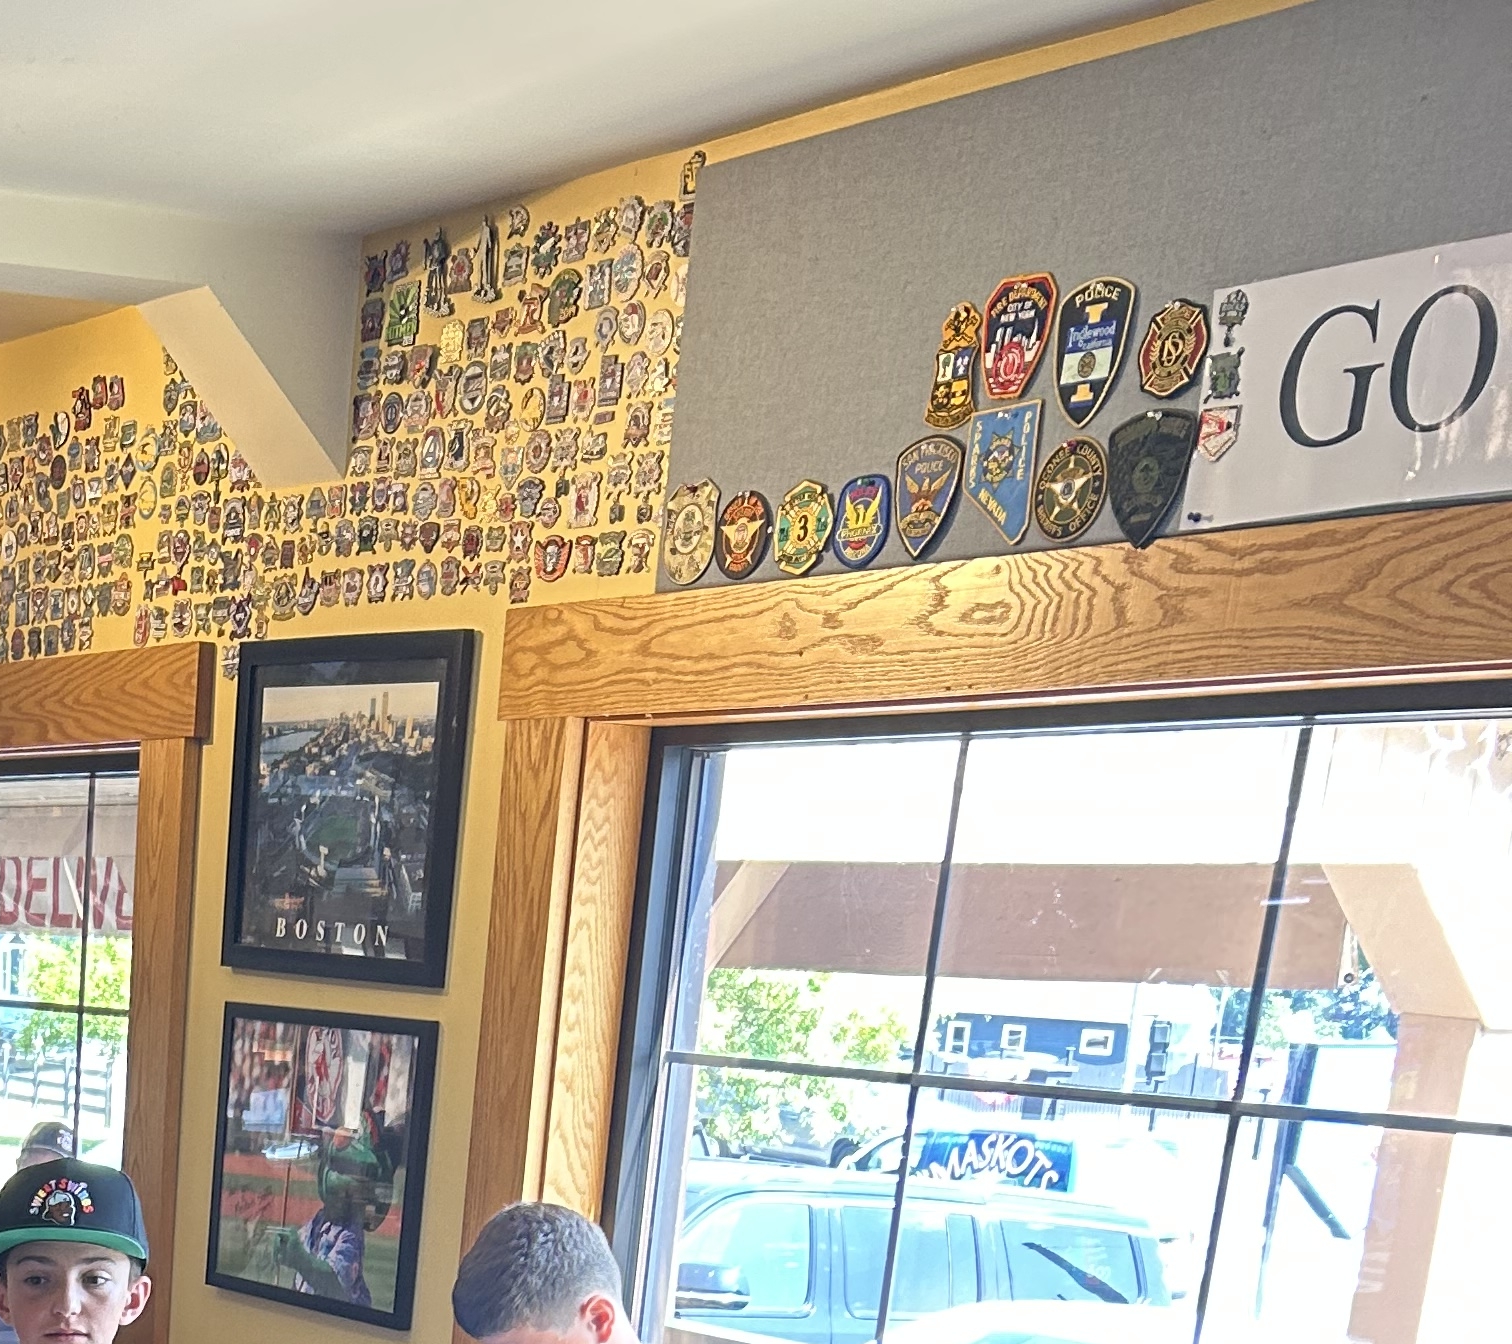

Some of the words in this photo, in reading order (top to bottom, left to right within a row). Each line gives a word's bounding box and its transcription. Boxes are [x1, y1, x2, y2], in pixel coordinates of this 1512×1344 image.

[1067, 320, 1116, 347] Inglewood
[1279, 284, 1498, 448] GO
[969, 420, 983, 489] SPARKS
[1016, 411, 1032, 482] POLICE
[1076, 444, 1102, 476] COUNTY
[978, 489, 1008, 526] NEVADA
[796, 513, 809, 542] 3
[275, 916, 389, 947] BOSTON
